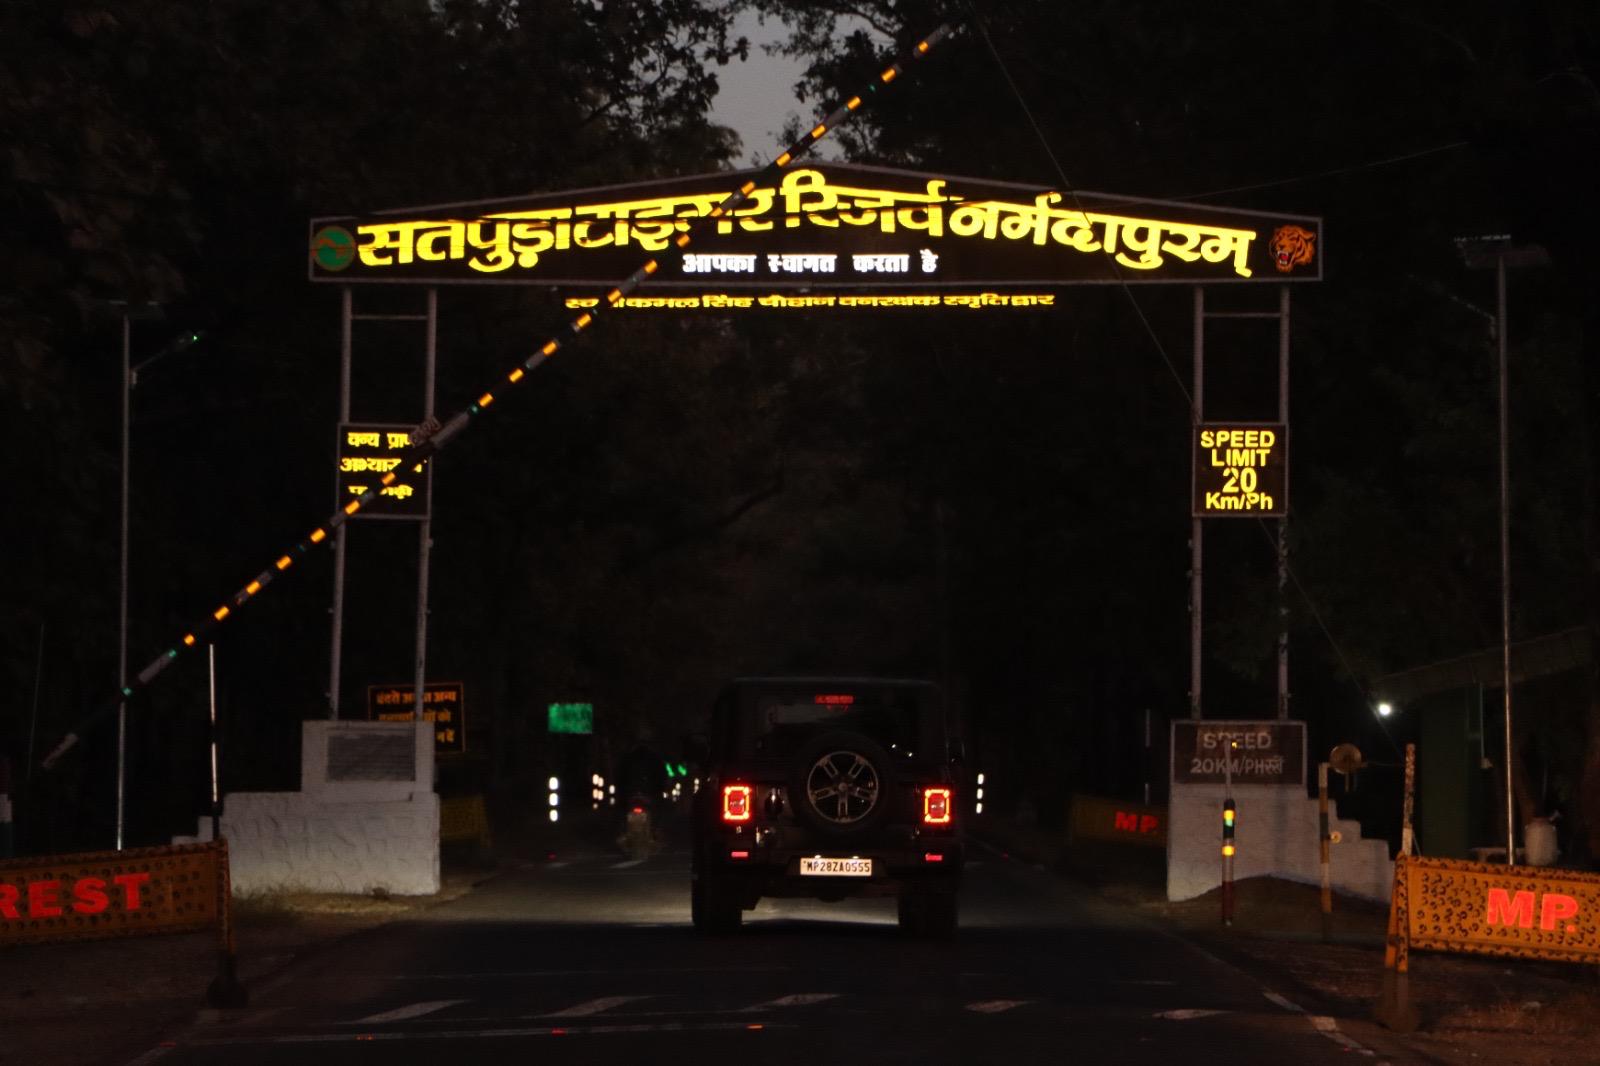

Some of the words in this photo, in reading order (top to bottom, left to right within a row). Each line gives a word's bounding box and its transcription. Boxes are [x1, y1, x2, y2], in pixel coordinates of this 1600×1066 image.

[356, 207, 570, 273] सतपुड़ा
[682, 253, 757, 274] आपका
[767, 253, 838, 274] स्वागत
[852, 253, 910, 274] करता
[920, 248, 939, 274] है
[1200, 430, 1275, 448] SPEED
[1211, 448, 1271, 467] LIMIT
[1222, 466, 1257, 493] 20
[1205, 491, 1273, 510] Km/Ph
[806, 861, 871, 873] MP28ZA0555
